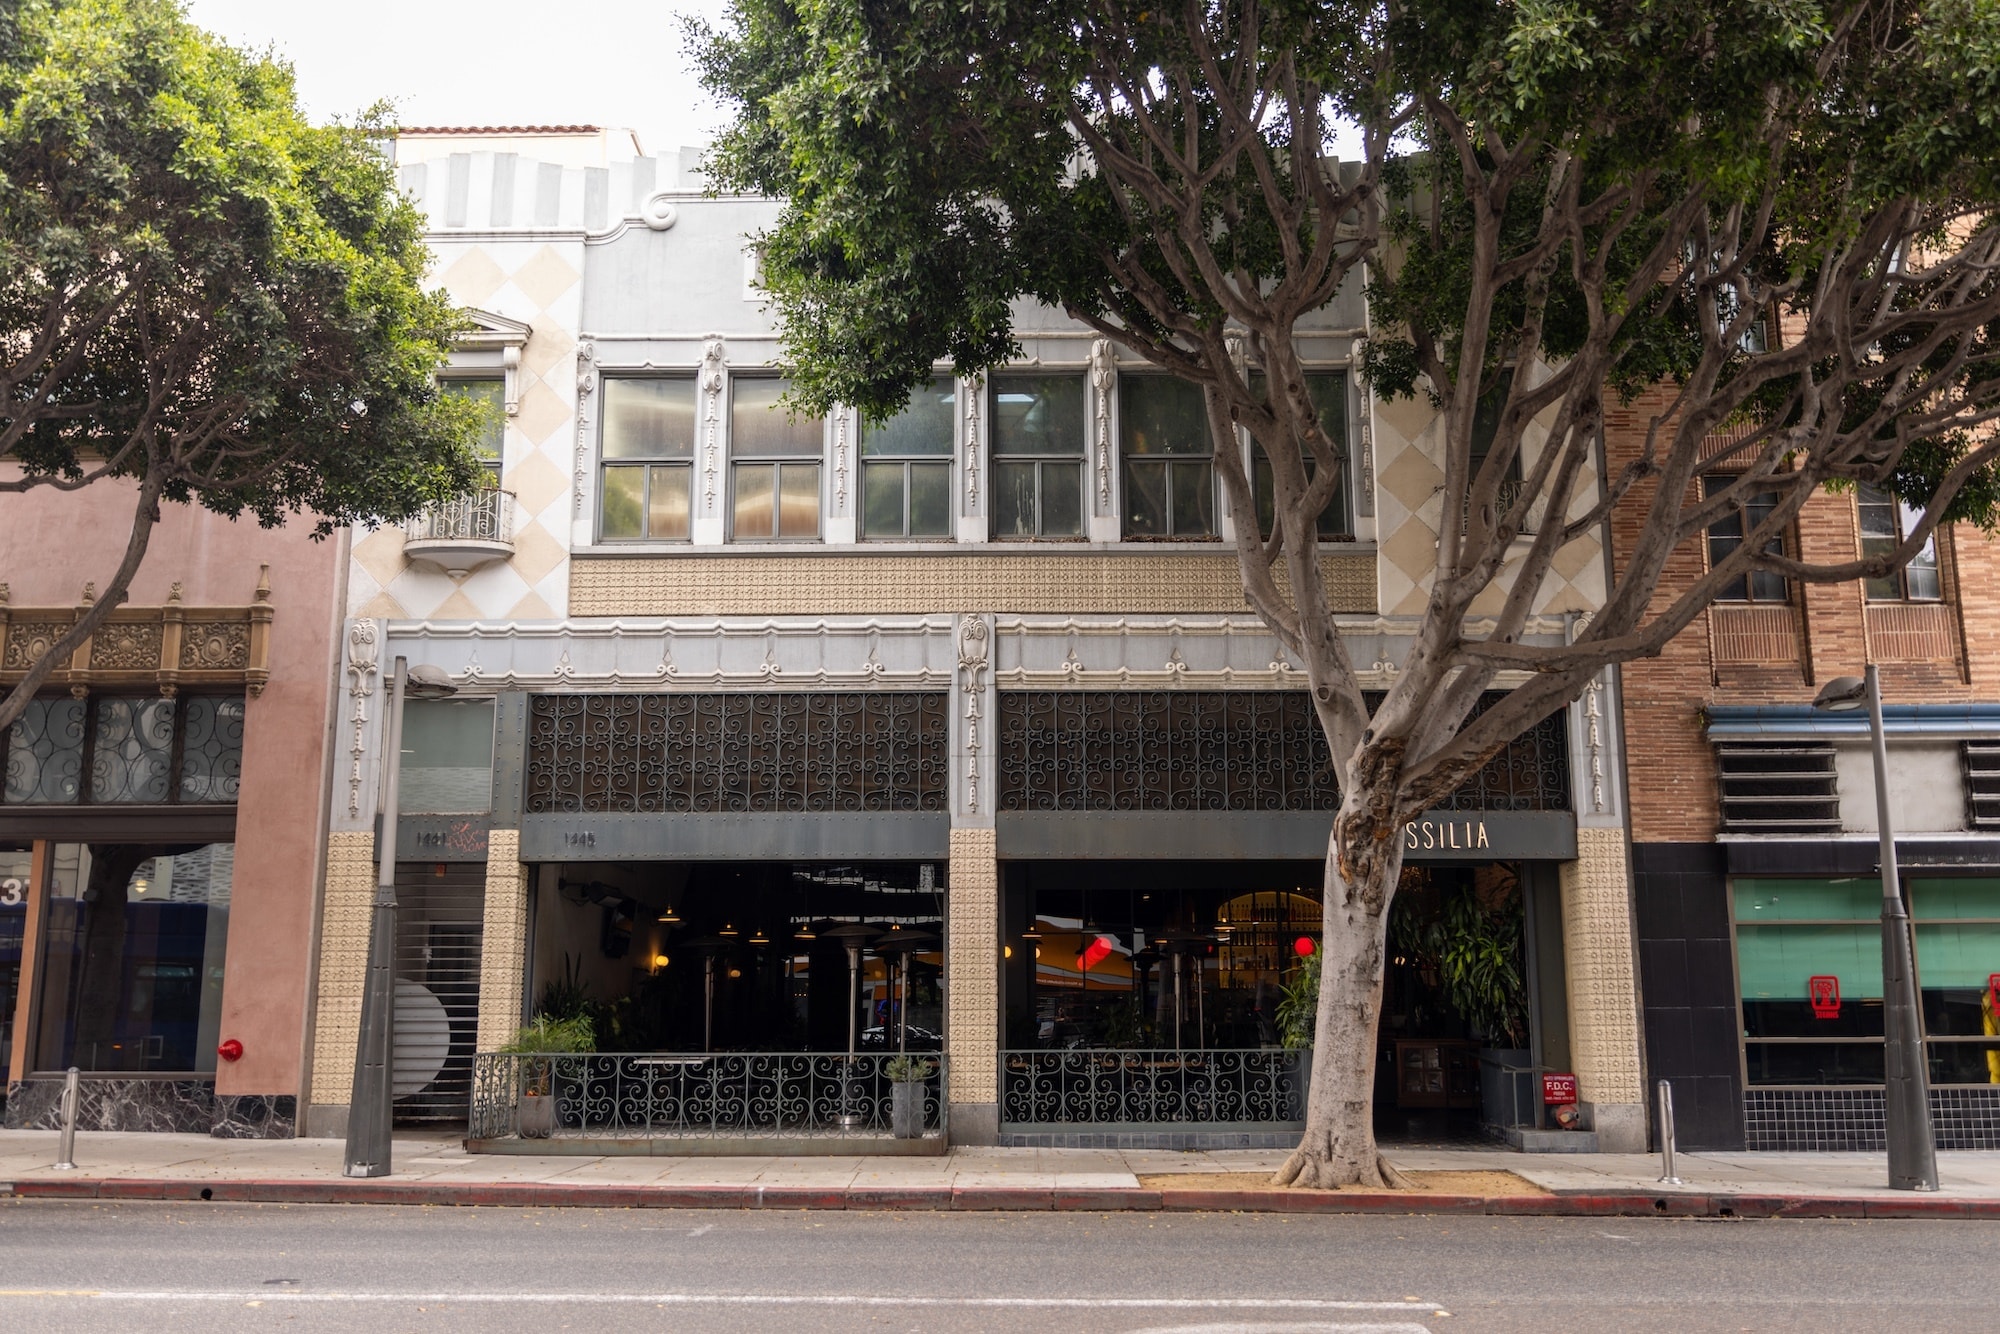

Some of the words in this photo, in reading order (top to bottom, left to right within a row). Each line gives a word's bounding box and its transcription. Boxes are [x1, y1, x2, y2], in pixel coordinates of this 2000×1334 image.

[1405, 821, 1489, 849] SSILIA
[1, 878, 30, 906] 3
[1546, 1082, 1572, 1090] F.D.C.
